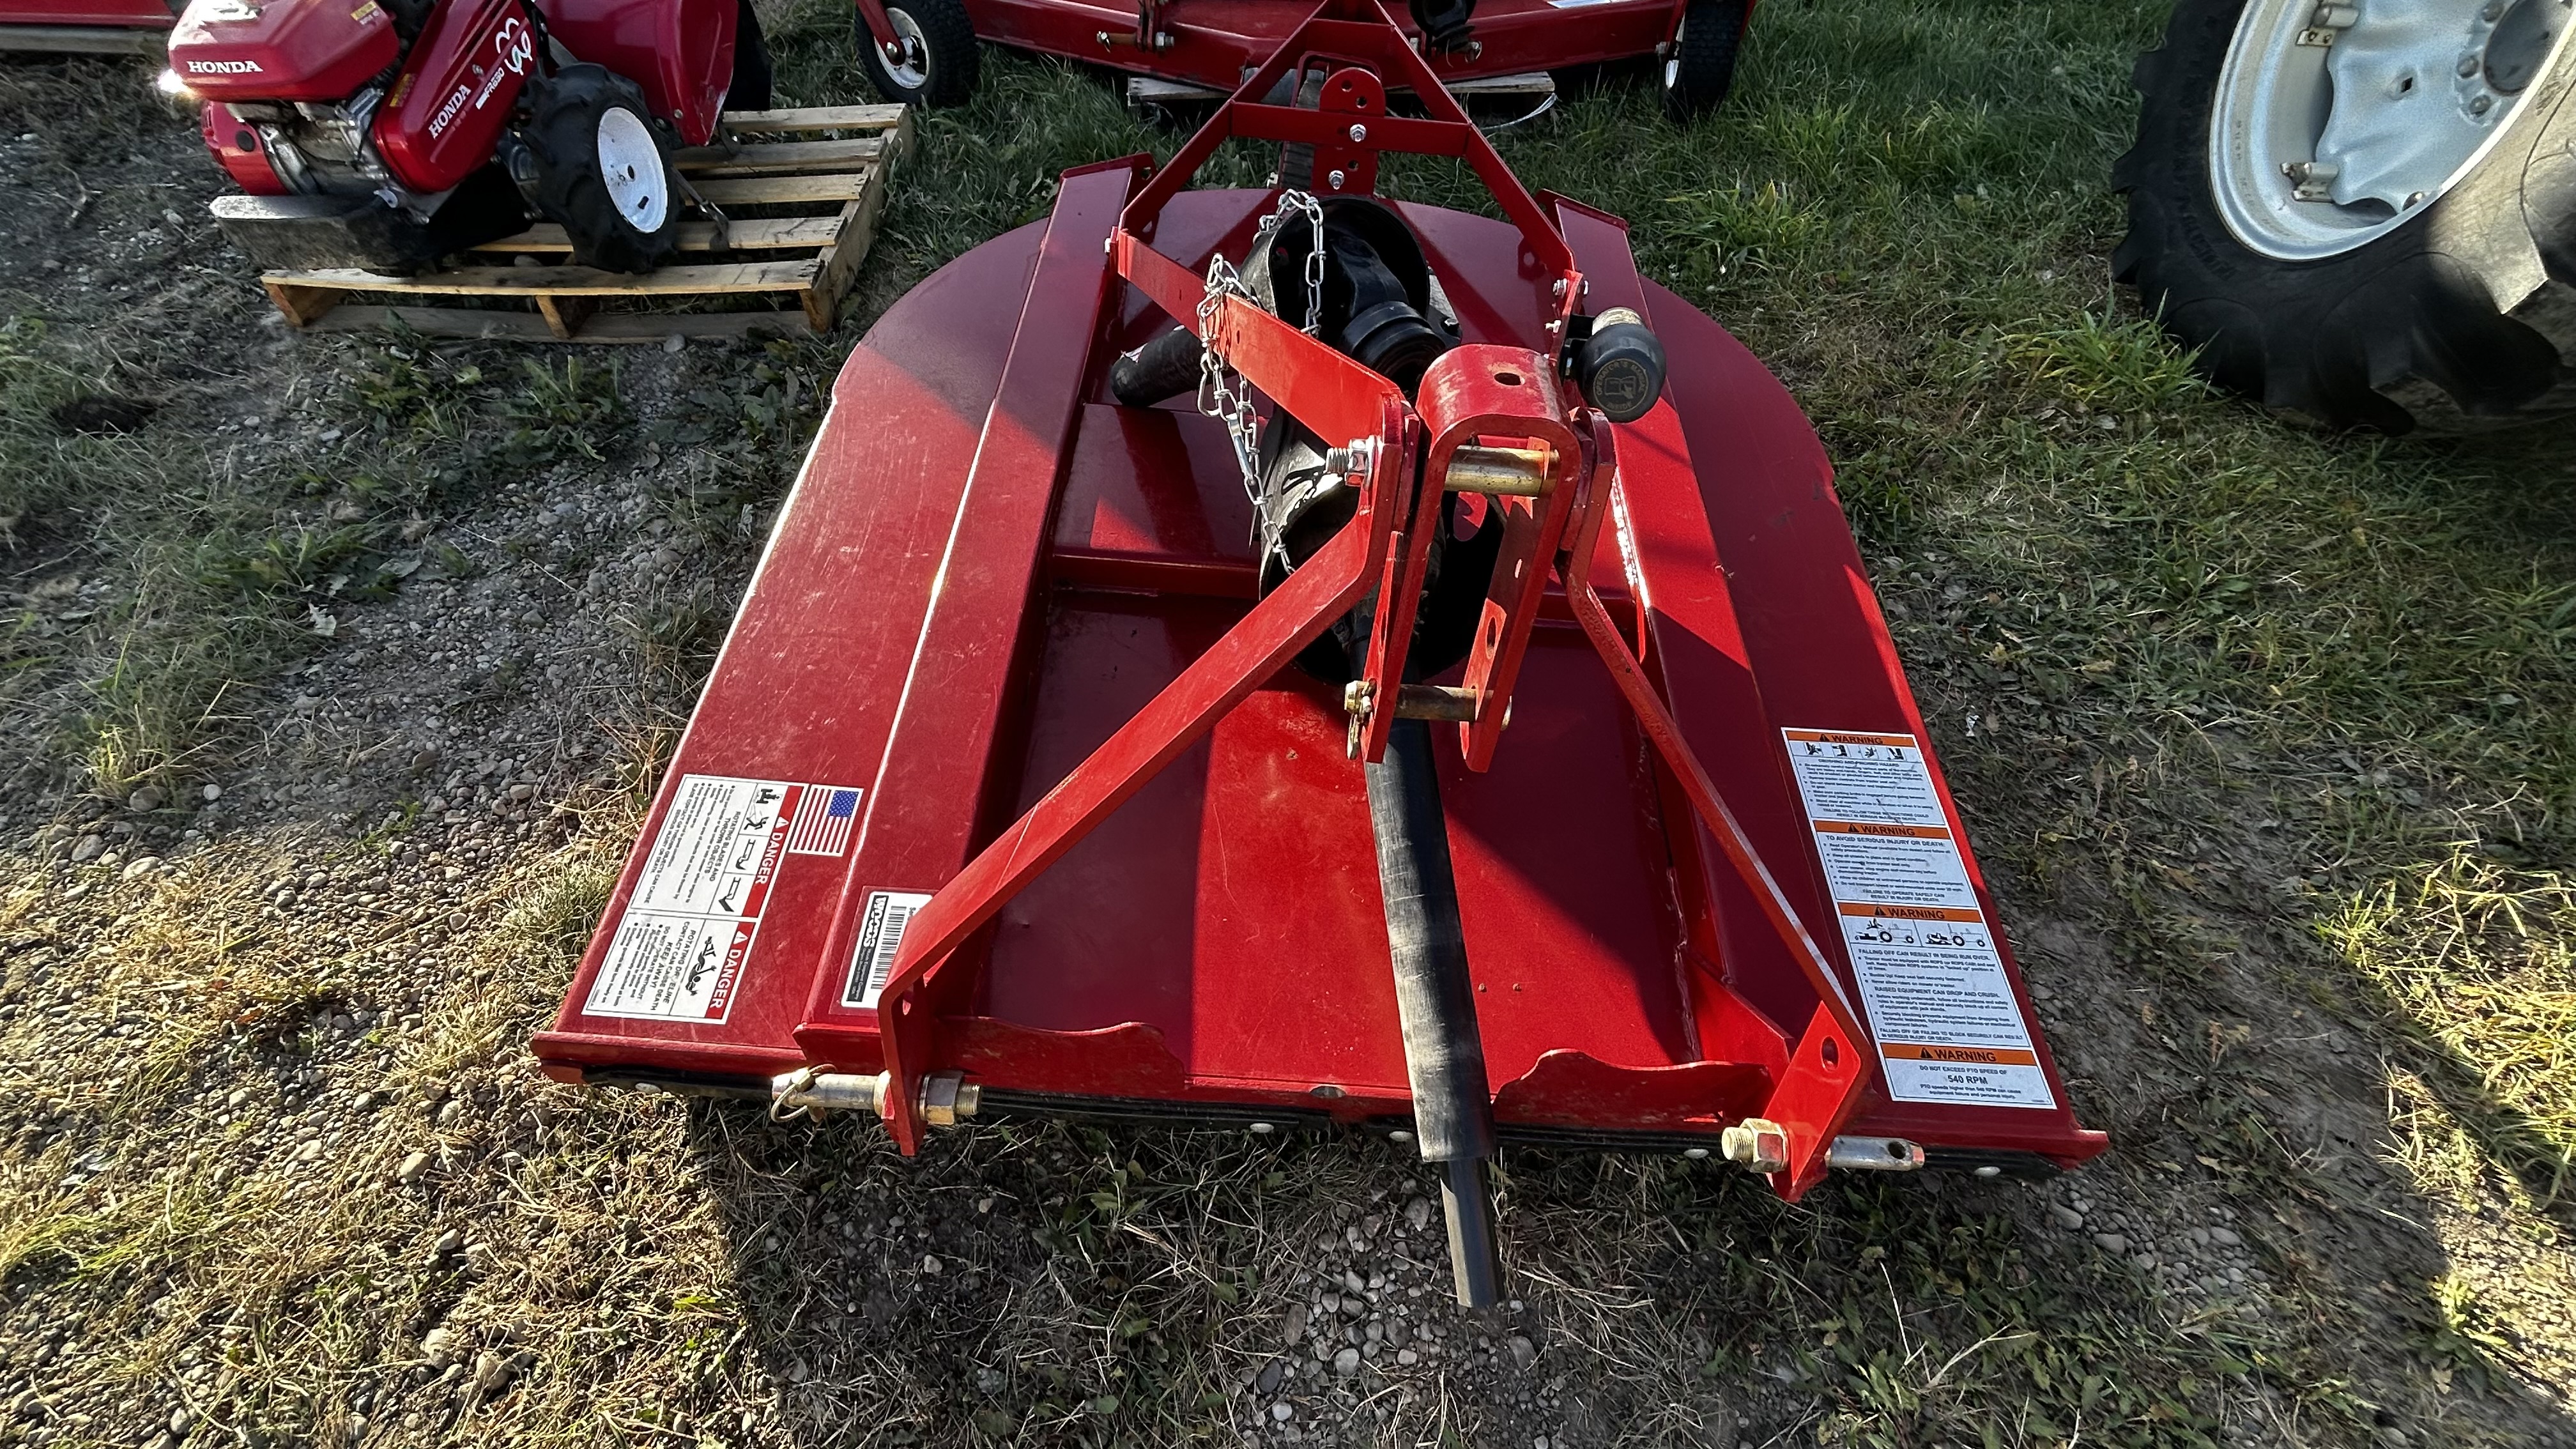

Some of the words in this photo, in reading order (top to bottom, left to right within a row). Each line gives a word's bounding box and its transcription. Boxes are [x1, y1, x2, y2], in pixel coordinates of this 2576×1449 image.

[187, 61, 263, 73] HONDA
[428, 84, 471, 139] HONDA
[1830, 735, 1884, 744] WARNING
[715, 817, 731, 843] THROWN
[724, 811, 742, 840] ROTATING
[1860, 825, 1916, 836] WARNING
[703, 845, 721, 873] OBJECTS
[714, 841, 730, 866] BLADES
[754, 832, 783, 884] DANGER
[708, 868, 719, 882] AND
[863, 897, 887, 947] WOODS
[1887, 907, 1946, 919] WARNING
[657, 935, 667, 947] NOT
[662, 926, 671, 934] DO
[673, 921, 690, 950] CONTACT
[668, 951, 678, 965] CAN
[677, 930, 696, 965] ROTATING
[635, 974, 652, 1000] WITHOUT
[648, 962, 666, 988] AWAY!
[662, 966, 682, 1004] DRELINE
[709, 948, 742, 1009] DANGER
[650, 989, 664, 1010] DEATH
[1934, 1048, 1997, 1062] WARNING
[1946, 1074, 1965, 1083] 540
[1965, 1075, 1988, 1084] RPM
